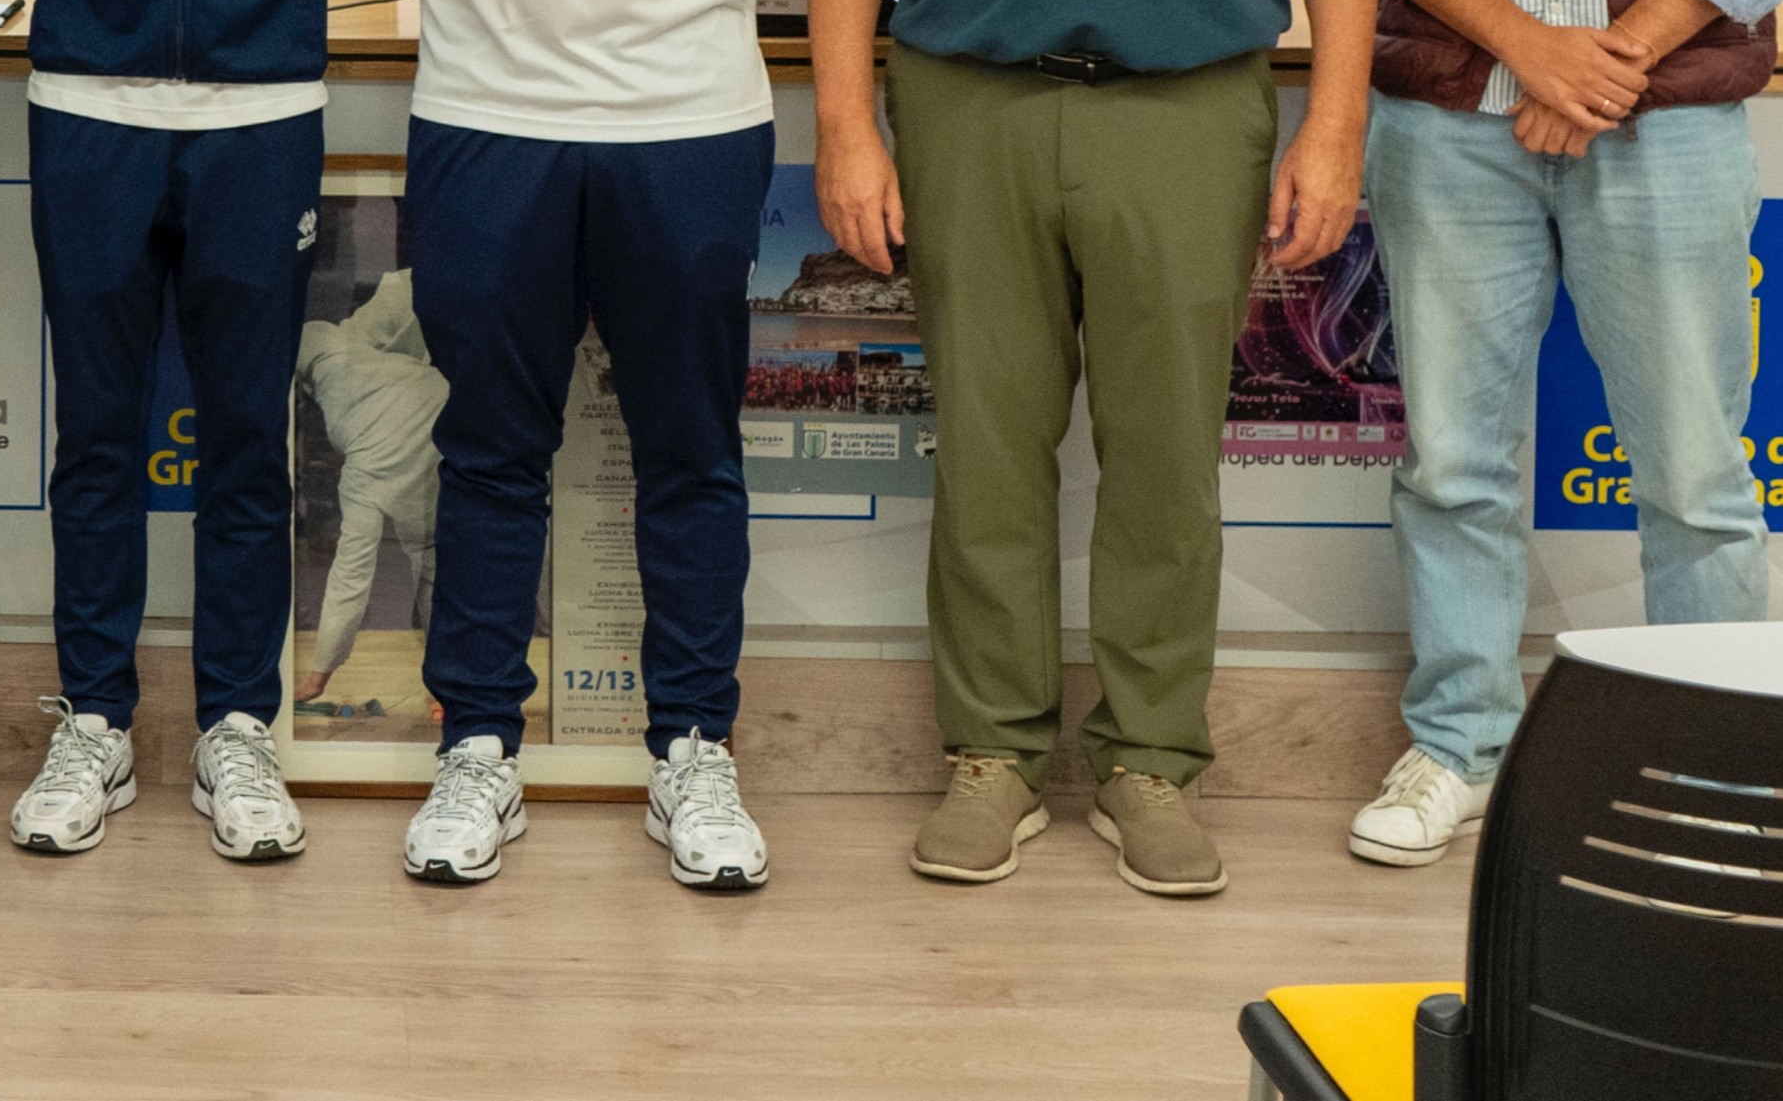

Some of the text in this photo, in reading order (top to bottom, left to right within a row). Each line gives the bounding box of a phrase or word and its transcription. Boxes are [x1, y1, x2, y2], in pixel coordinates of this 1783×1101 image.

[831, 432, 896, 440] Ayuntamiento
[865, 440, 896, 449] Palmas
[563, 669, 636, 692] 12/13
[567, 694, 634, 702] DICIEMBRE
[560, 726, 622, 735] ENTRADA
